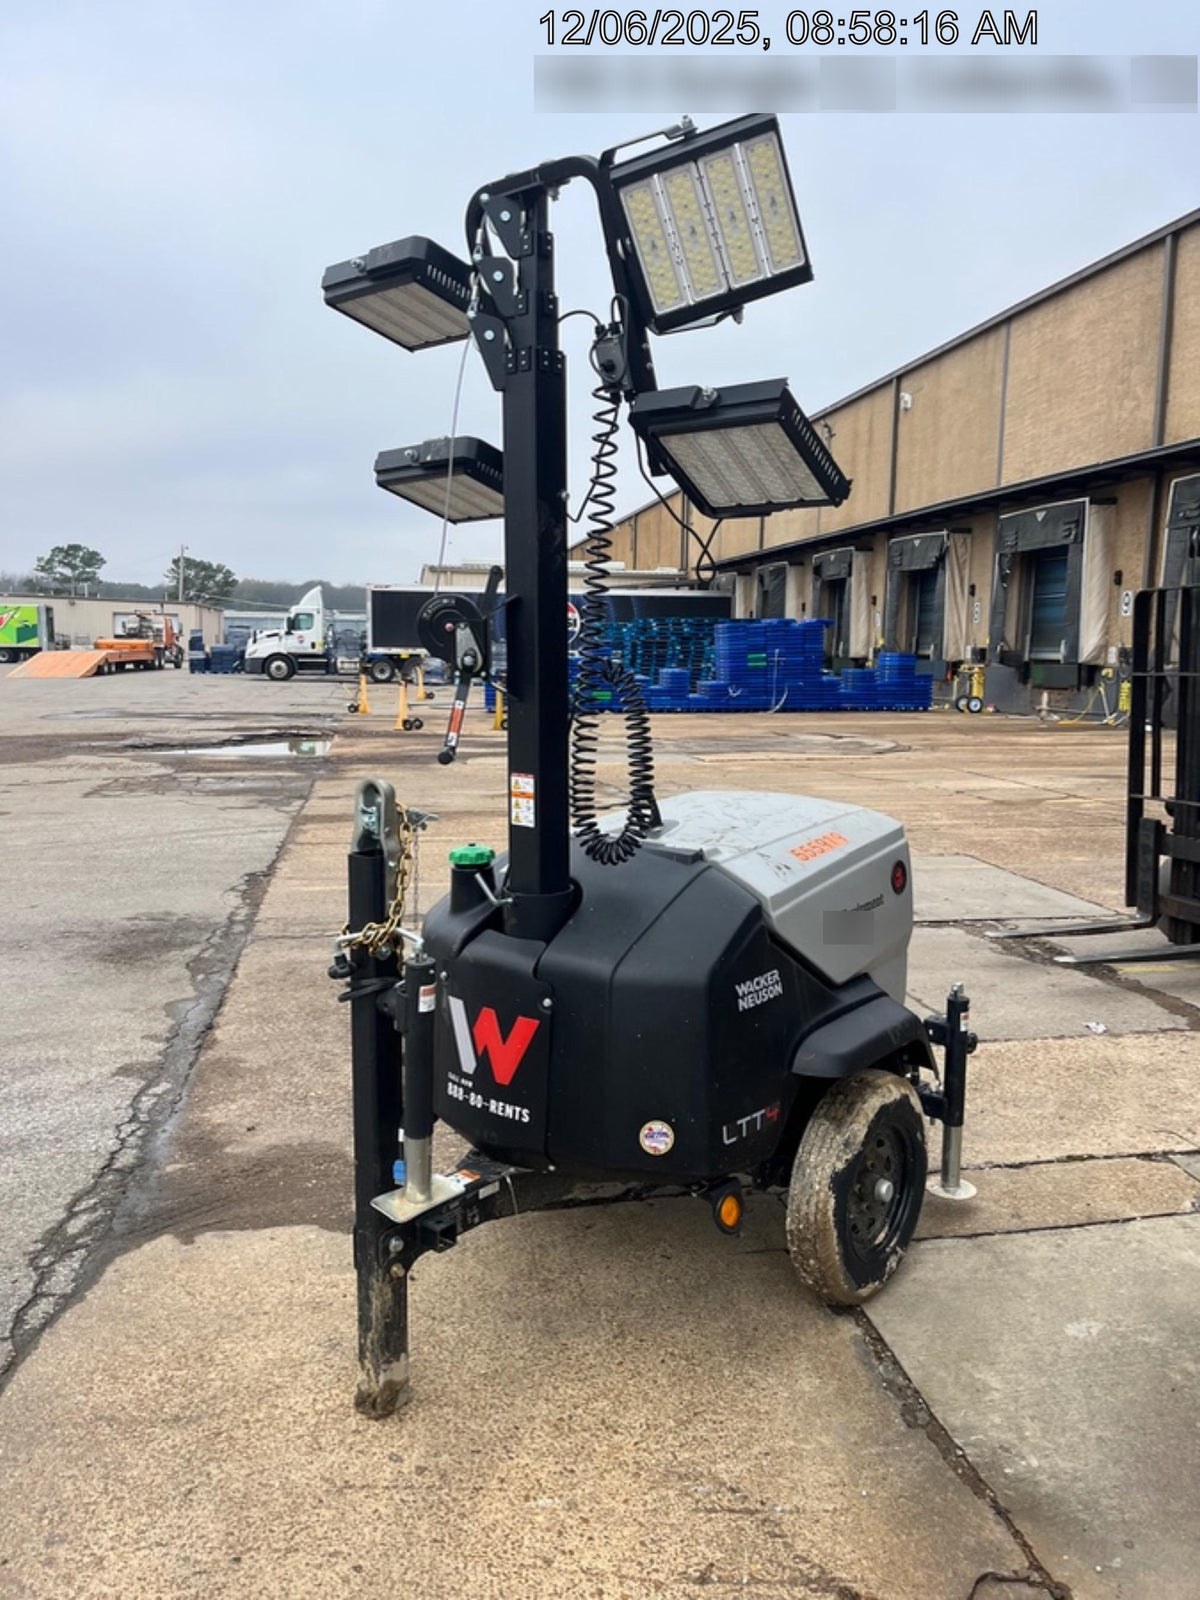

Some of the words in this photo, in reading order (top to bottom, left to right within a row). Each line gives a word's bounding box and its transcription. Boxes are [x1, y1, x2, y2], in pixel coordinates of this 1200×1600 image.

[735, 969, 781, 997] WACKER
[737, 981, 783, 1012] NEUSON
[447, 1081, 531, 1123] 888-80-RENTS
